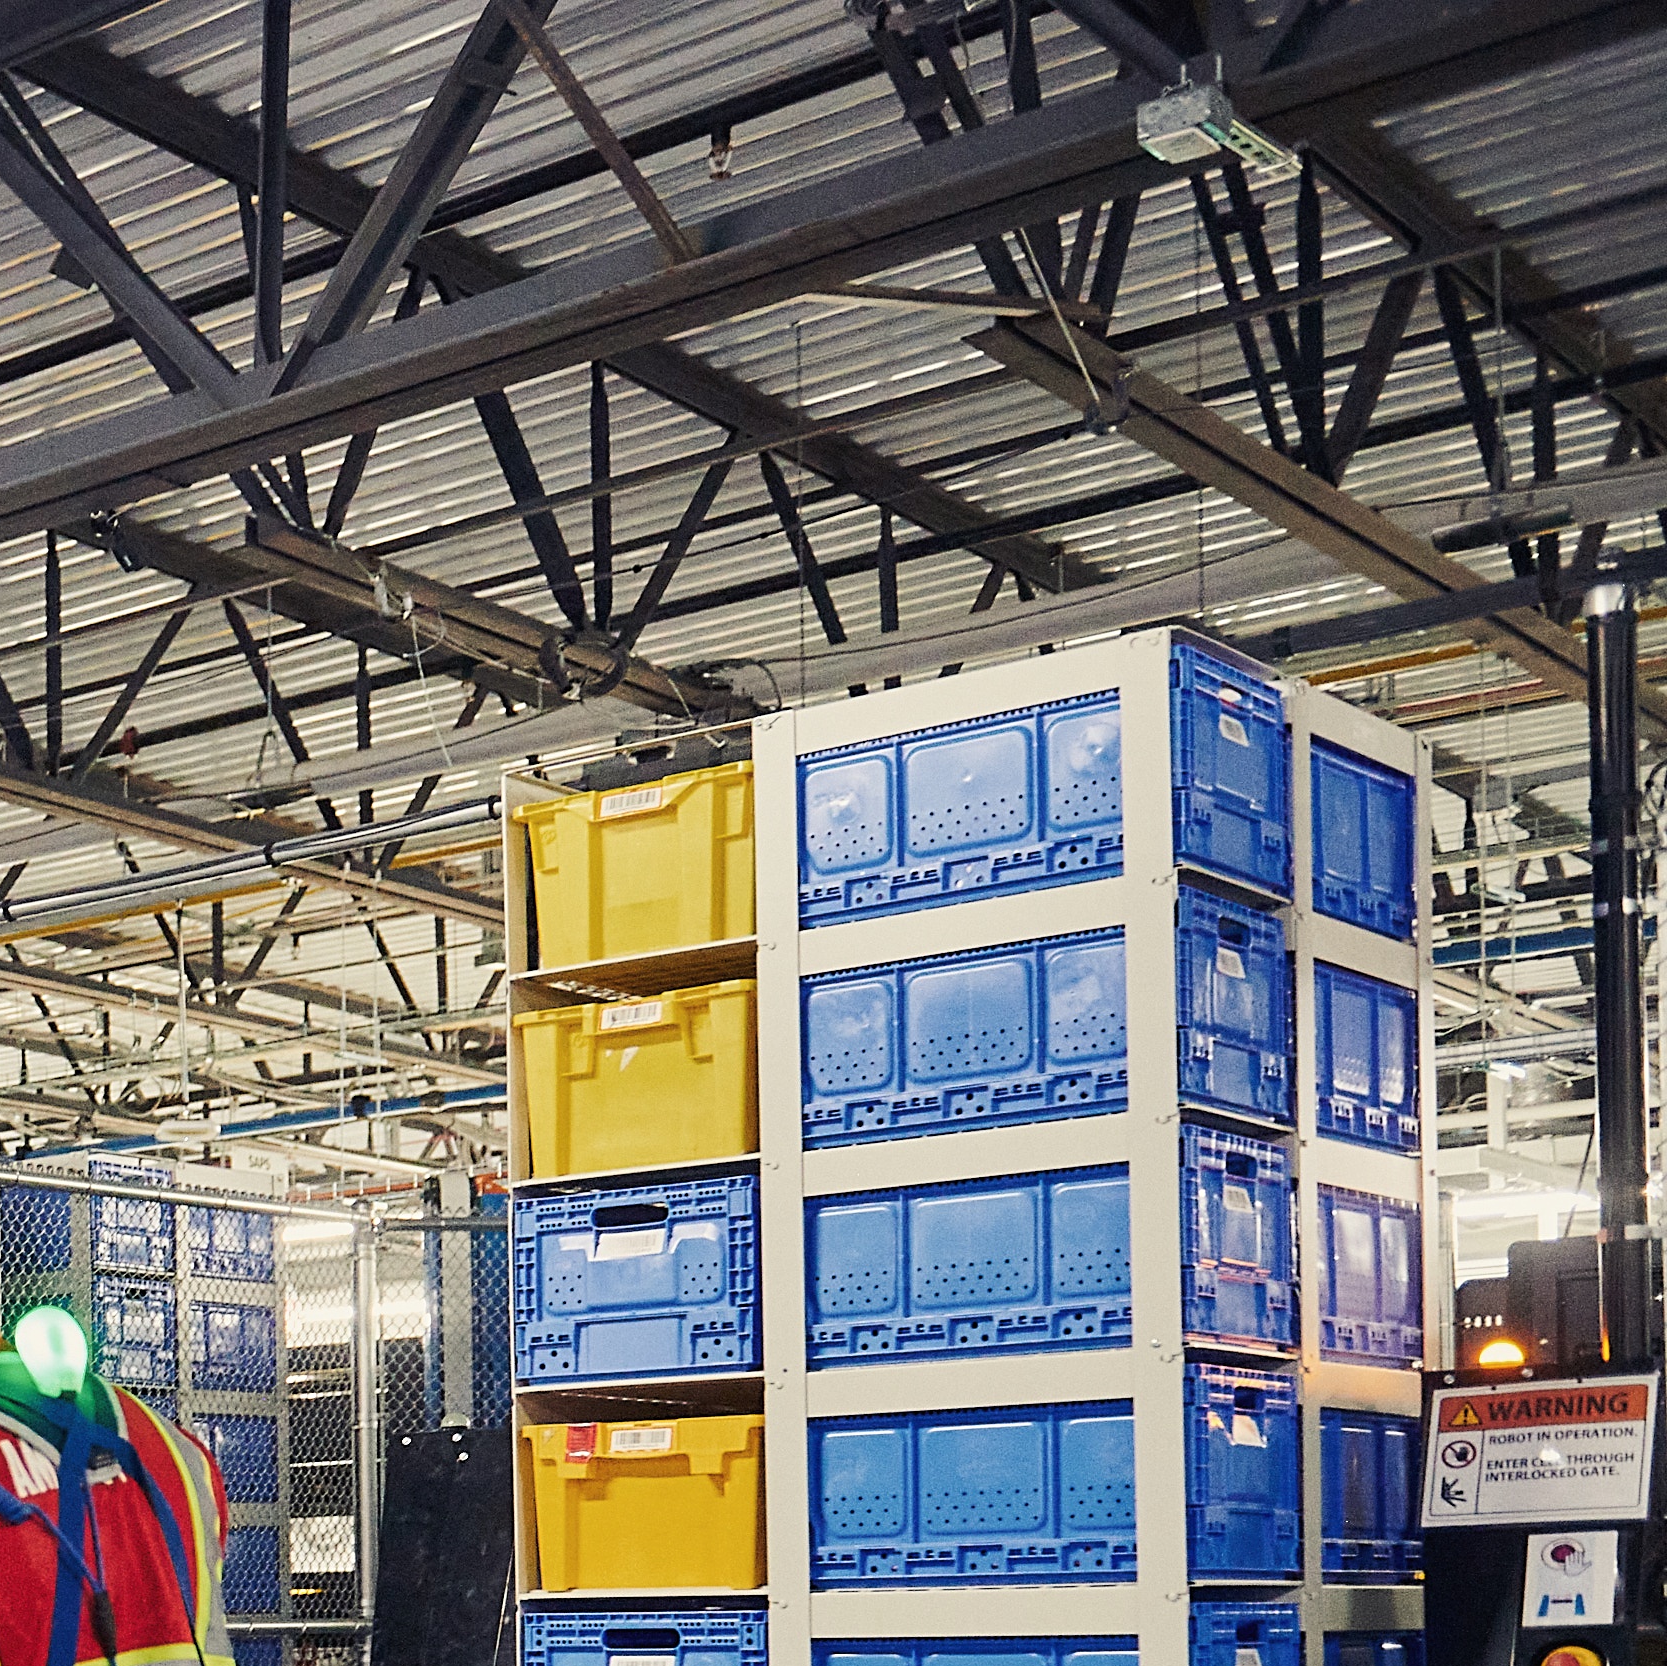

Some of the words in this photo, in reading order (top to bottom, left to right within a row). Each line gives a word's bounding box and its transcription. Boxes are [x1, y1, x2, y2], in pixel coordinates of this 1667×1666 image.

[1487, 1392, 1630, 1421] WARNING
[1489, 1433, 1532, 1445] ROBOT
[1537, 1431, 1551, 1442] IN
[1555, 1427, 1638, 1440] OPERATION.
[1486, 1458, 1528, 1470] ENTER
[1566, 1452, 1635, 1465] THROUGH
[1485, 1469, 1577, 1482] INTERLOCKED
[1580, 1466, 1620, 1477] GATE.
